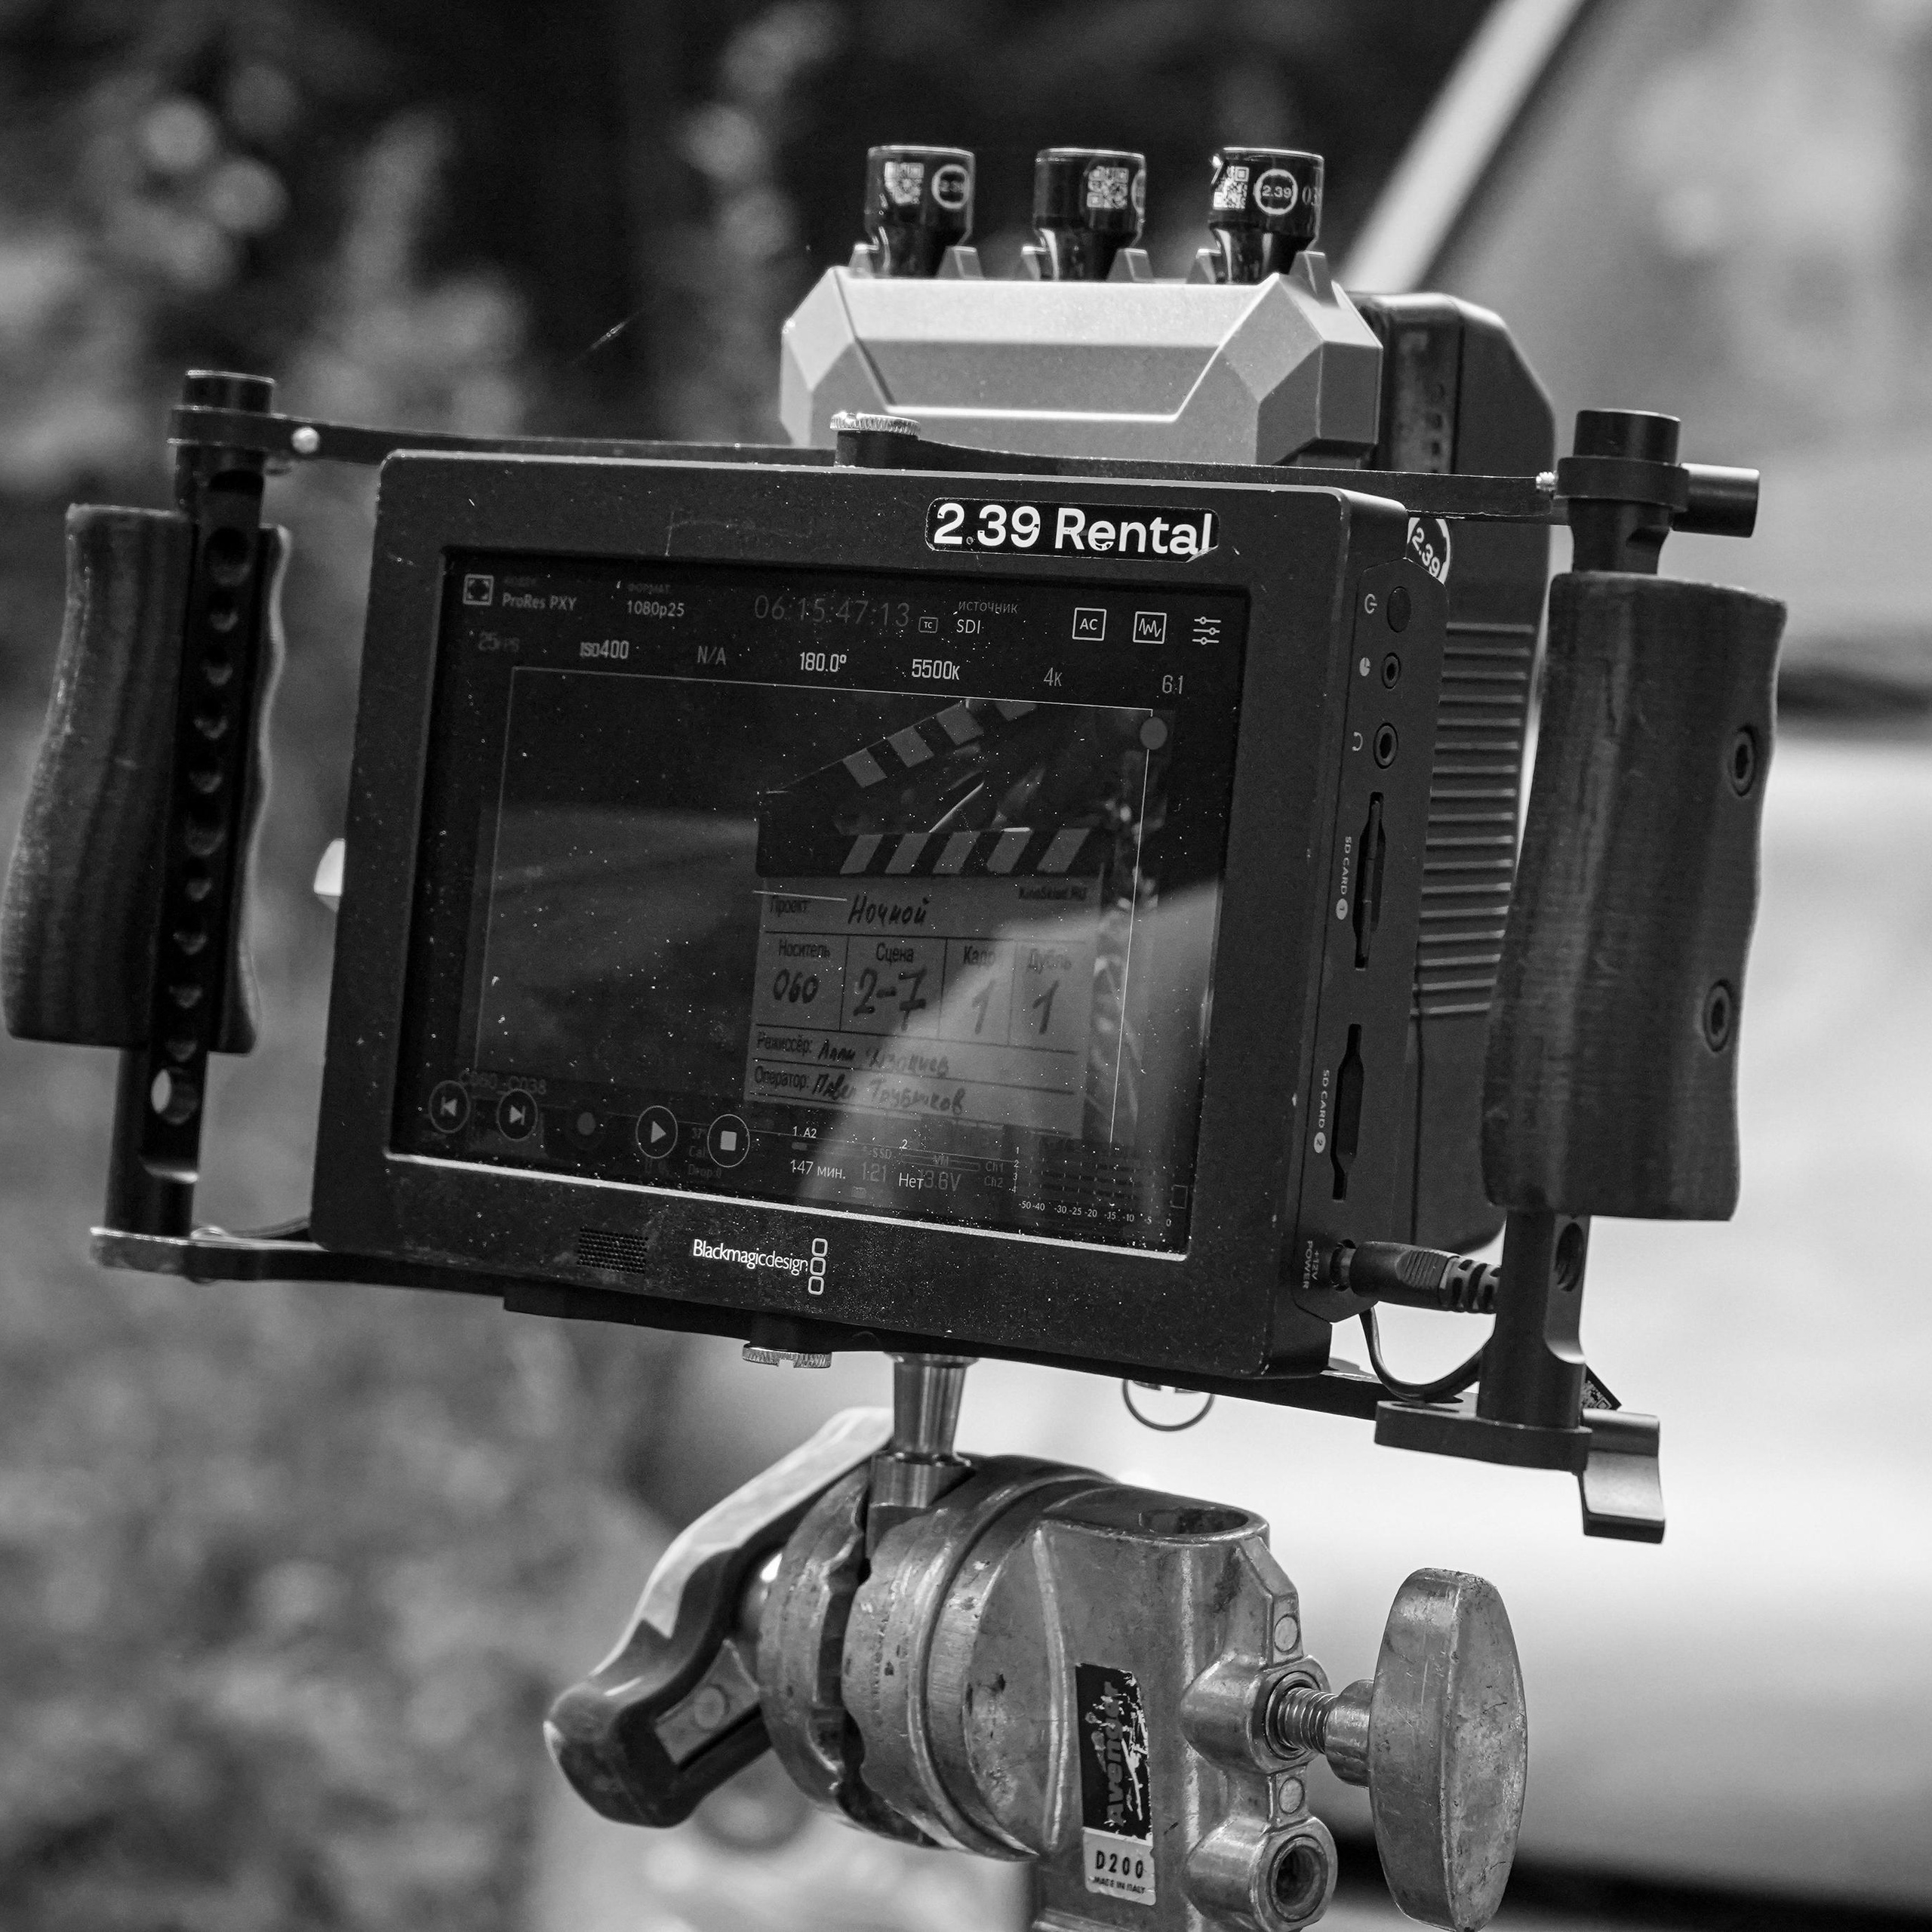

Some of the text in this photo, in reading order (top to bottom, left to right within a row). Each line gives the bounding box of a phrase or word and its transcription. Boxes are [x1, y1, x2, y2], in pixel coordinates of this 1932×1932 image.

[1262, 185, 1292, 199] 2.39
[1054, 507, 1214, 555] Rental
[1412, 527, 1441, 578] 2.39
[502, 592, 577, 611] ProRes PXY
[627, 600, 685, 619] 1080p25
[957, 601, 1020, 614] ИСТОЧНИК
[924, 620, 933, 629] TC
[956, 618, 981, 635] SDI
[1079, 617, 1099, 632] AC
[697, 645, 727, 666] N/A
[1340, 857, 1349, 895] CARD
[876, 942, 915, 964] Сцена
[773, 968, 819, 1004] 060
[972, 979, 996, 1035] 1
[1032, 979, 1059, 1035] 1
[1318, 1090, 1328, 1129] CARD
[900, 1138, 908, 1149] 2
[790, 1159, 814, 1175] 147
[898, 1172, 924, 1190] Нет
[693, 1238, 808, 1276] Blackmagicdesign
[1096, 1849, 1143, 1879] D200
